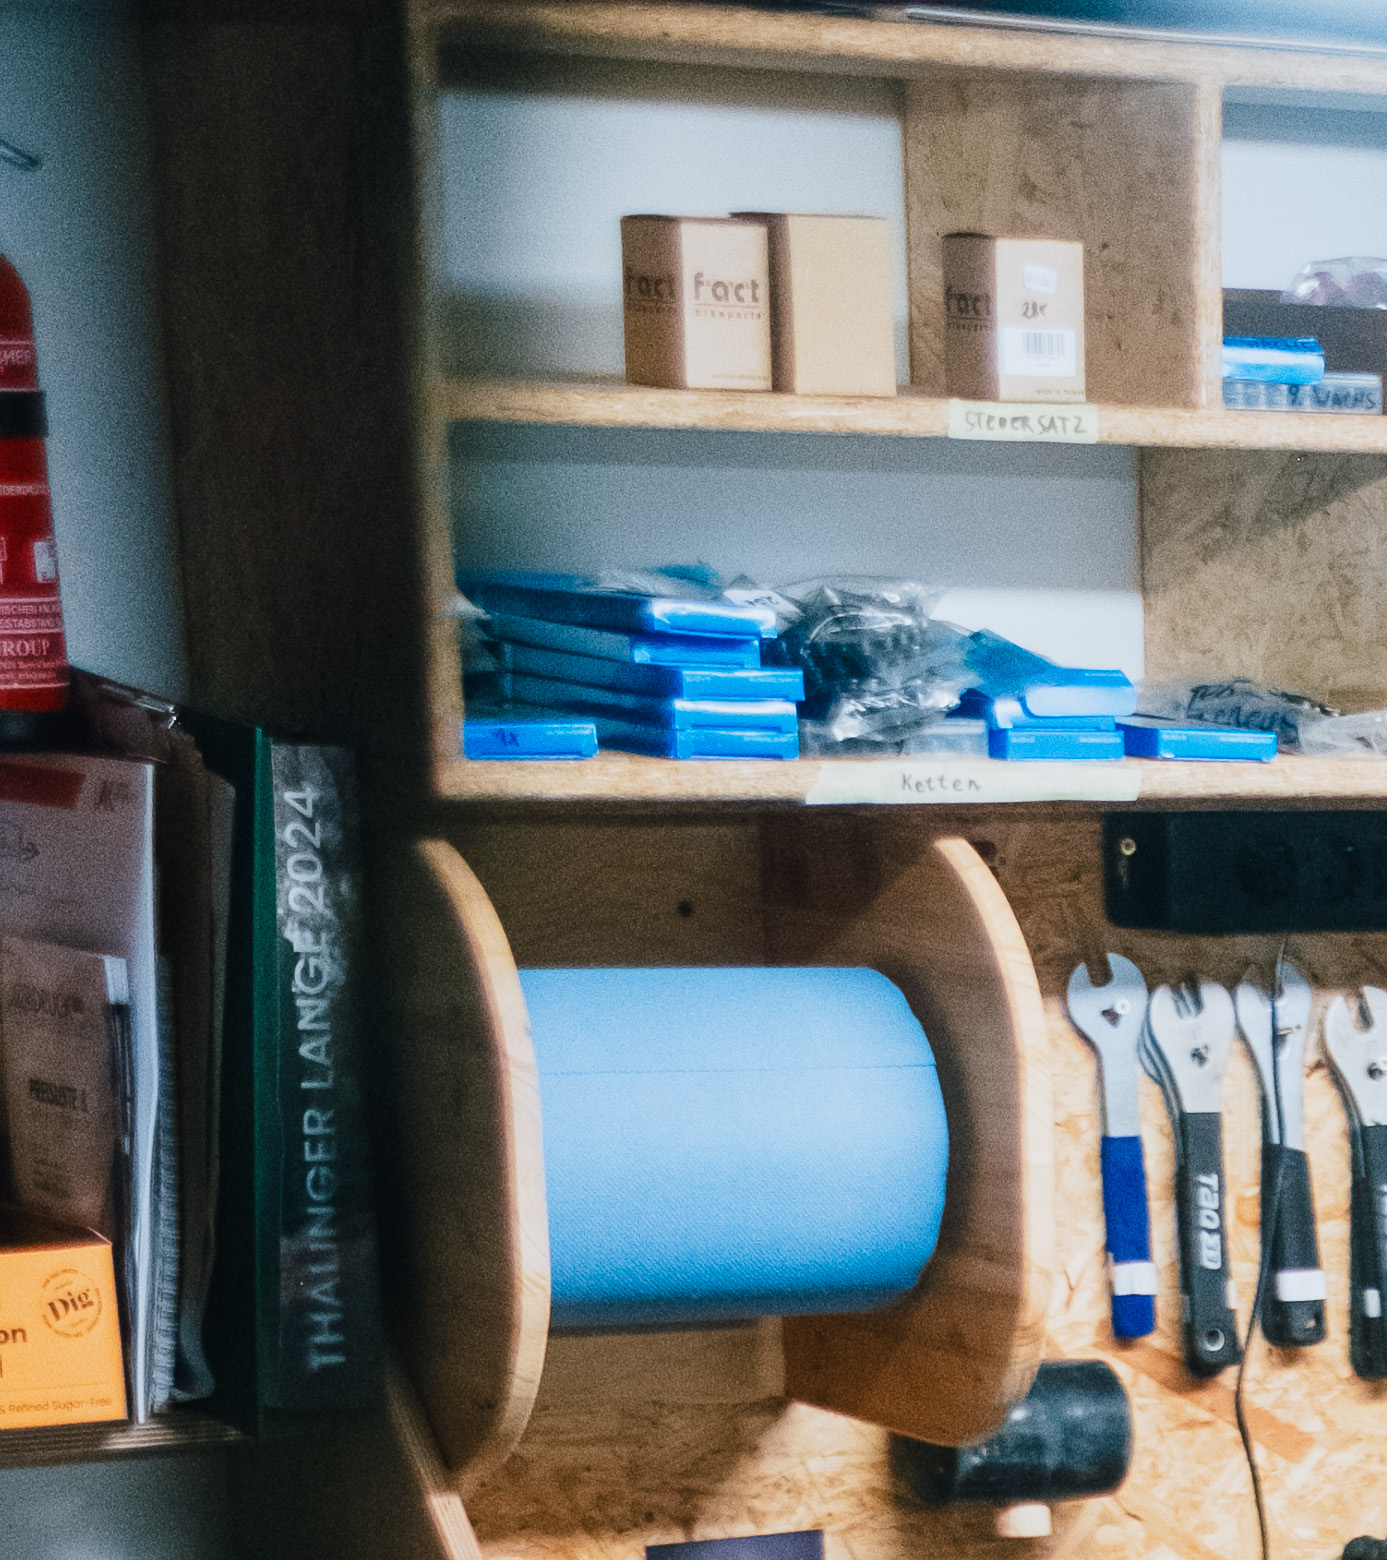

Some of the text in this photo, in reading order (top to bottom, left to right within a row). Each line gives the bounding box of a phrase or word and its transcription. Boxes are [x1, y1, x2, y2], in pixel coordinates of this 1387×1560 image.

[694, 271, 761, 305] fact
[900, 771, 982, 794] Ketten
[283, 786, 322, 913] 2024
[303, 1106, 347, 1373] THALINGER
[47, 1287, 95, 1323] Dig
